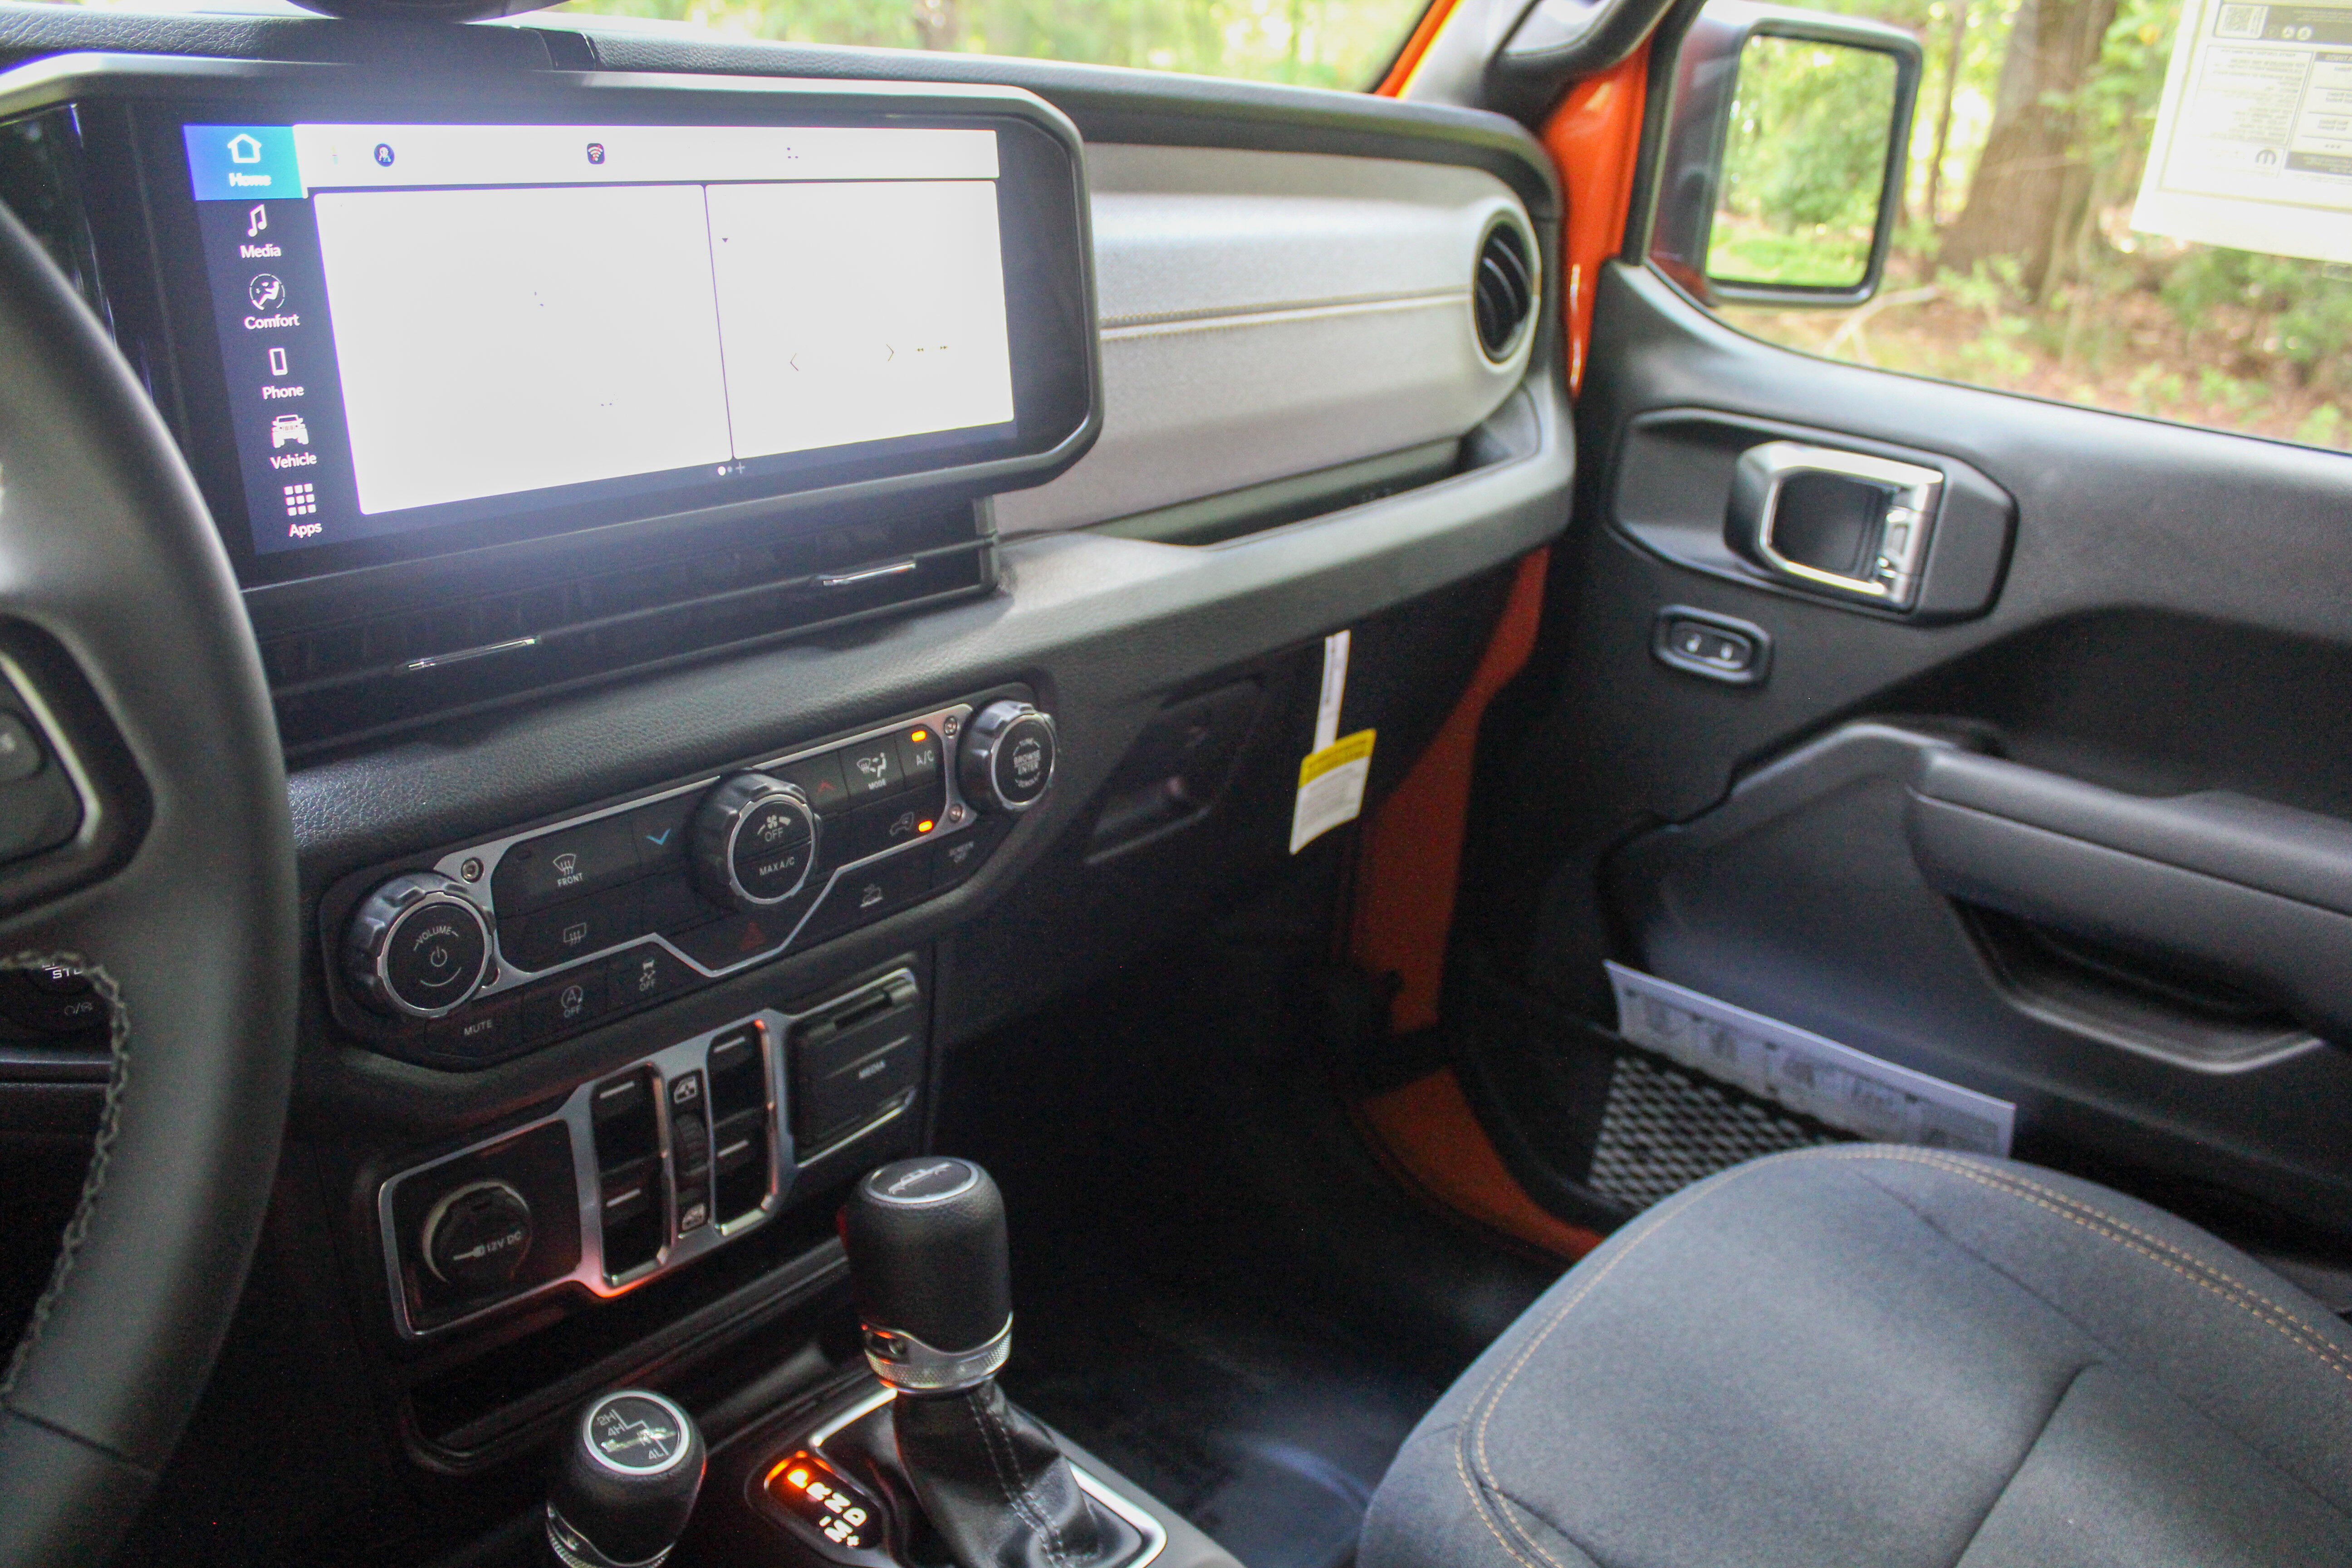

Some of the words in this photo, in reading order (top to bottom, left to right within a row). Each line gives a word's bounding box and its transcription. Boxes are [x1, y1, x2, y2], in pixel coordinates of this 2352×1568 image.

[229, 172, 272, 187] Home
[240, 243, 282, 259] Media
[244, 313, 300, 330] Comfort
[262, 384, 304, 400] Phone
[270, 452, 317, 469] Vehicle
[289, 522, 323, 539] Apps
[916, 750, 934, 766] A/C
[867, 778, 887, 790] MODE
[764, 826, 784, 842] OFF
[557, 872, 583, 887] FRONT
[416, 925, 452, 944] VOLUME
[639, 978, 656, 992] OFF
[564, 1005, 582, 1019] OFF
[464, 1019, 493, 1036] MUTE
[486, 1238, 505, 1252] 12V
[507, 1230, 521, 1245] DC
[607, 1422, 626, 1436] 4H
[787, 1469, 809, 1489] P
[806, 1481, 833, 1501] R
[824, 1492, 851, 1514] N
[842, 1507, 867, 1527] D
